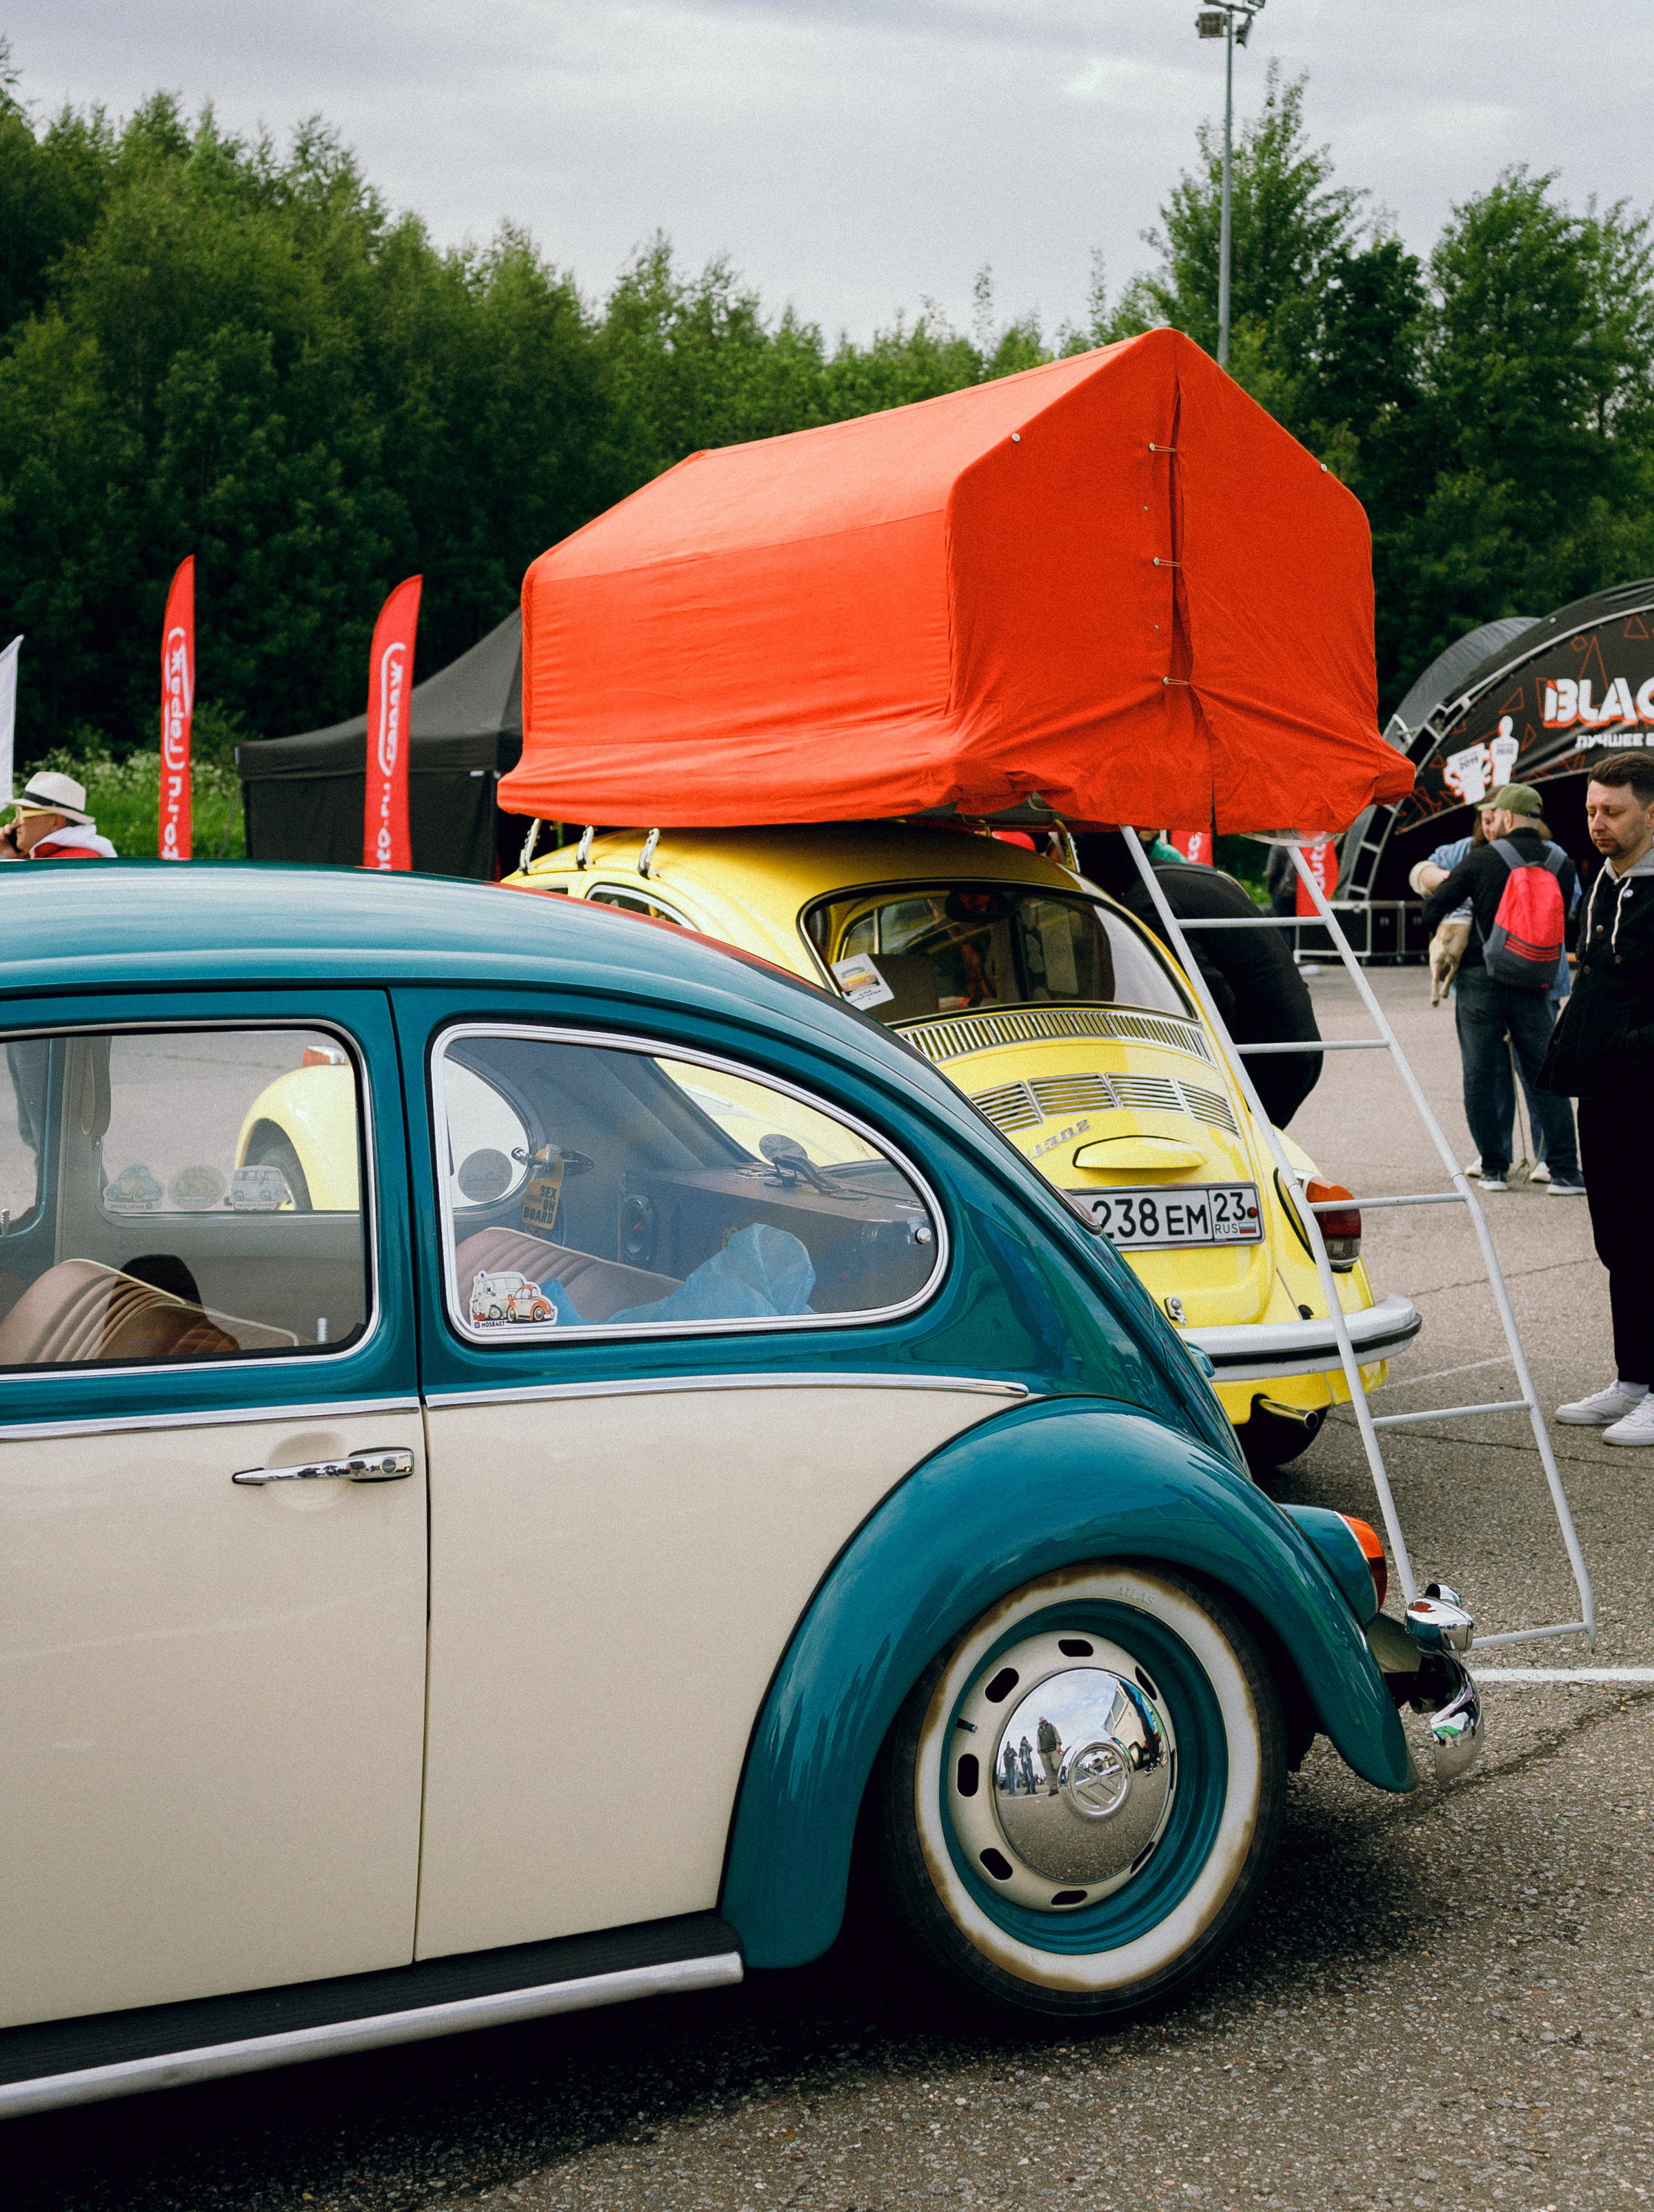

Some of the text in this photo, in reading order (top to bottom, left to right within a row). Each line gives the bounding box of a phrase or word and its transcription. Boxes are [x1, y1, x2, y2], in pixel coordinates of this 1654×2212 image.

[1575, 733, 1644, 749] ЛУЧШЕЕ
[540, 1185, 557, 1200] SEX
[543, 1199, 556, 1212] ON
[1213, 1193, 1246, 1222] 23
[523, 1206, 554, 1224] BOARD
[1214, 1224, 1238, 1235] RUS
[1115, 1585, 1155, 1605] ATLAS
